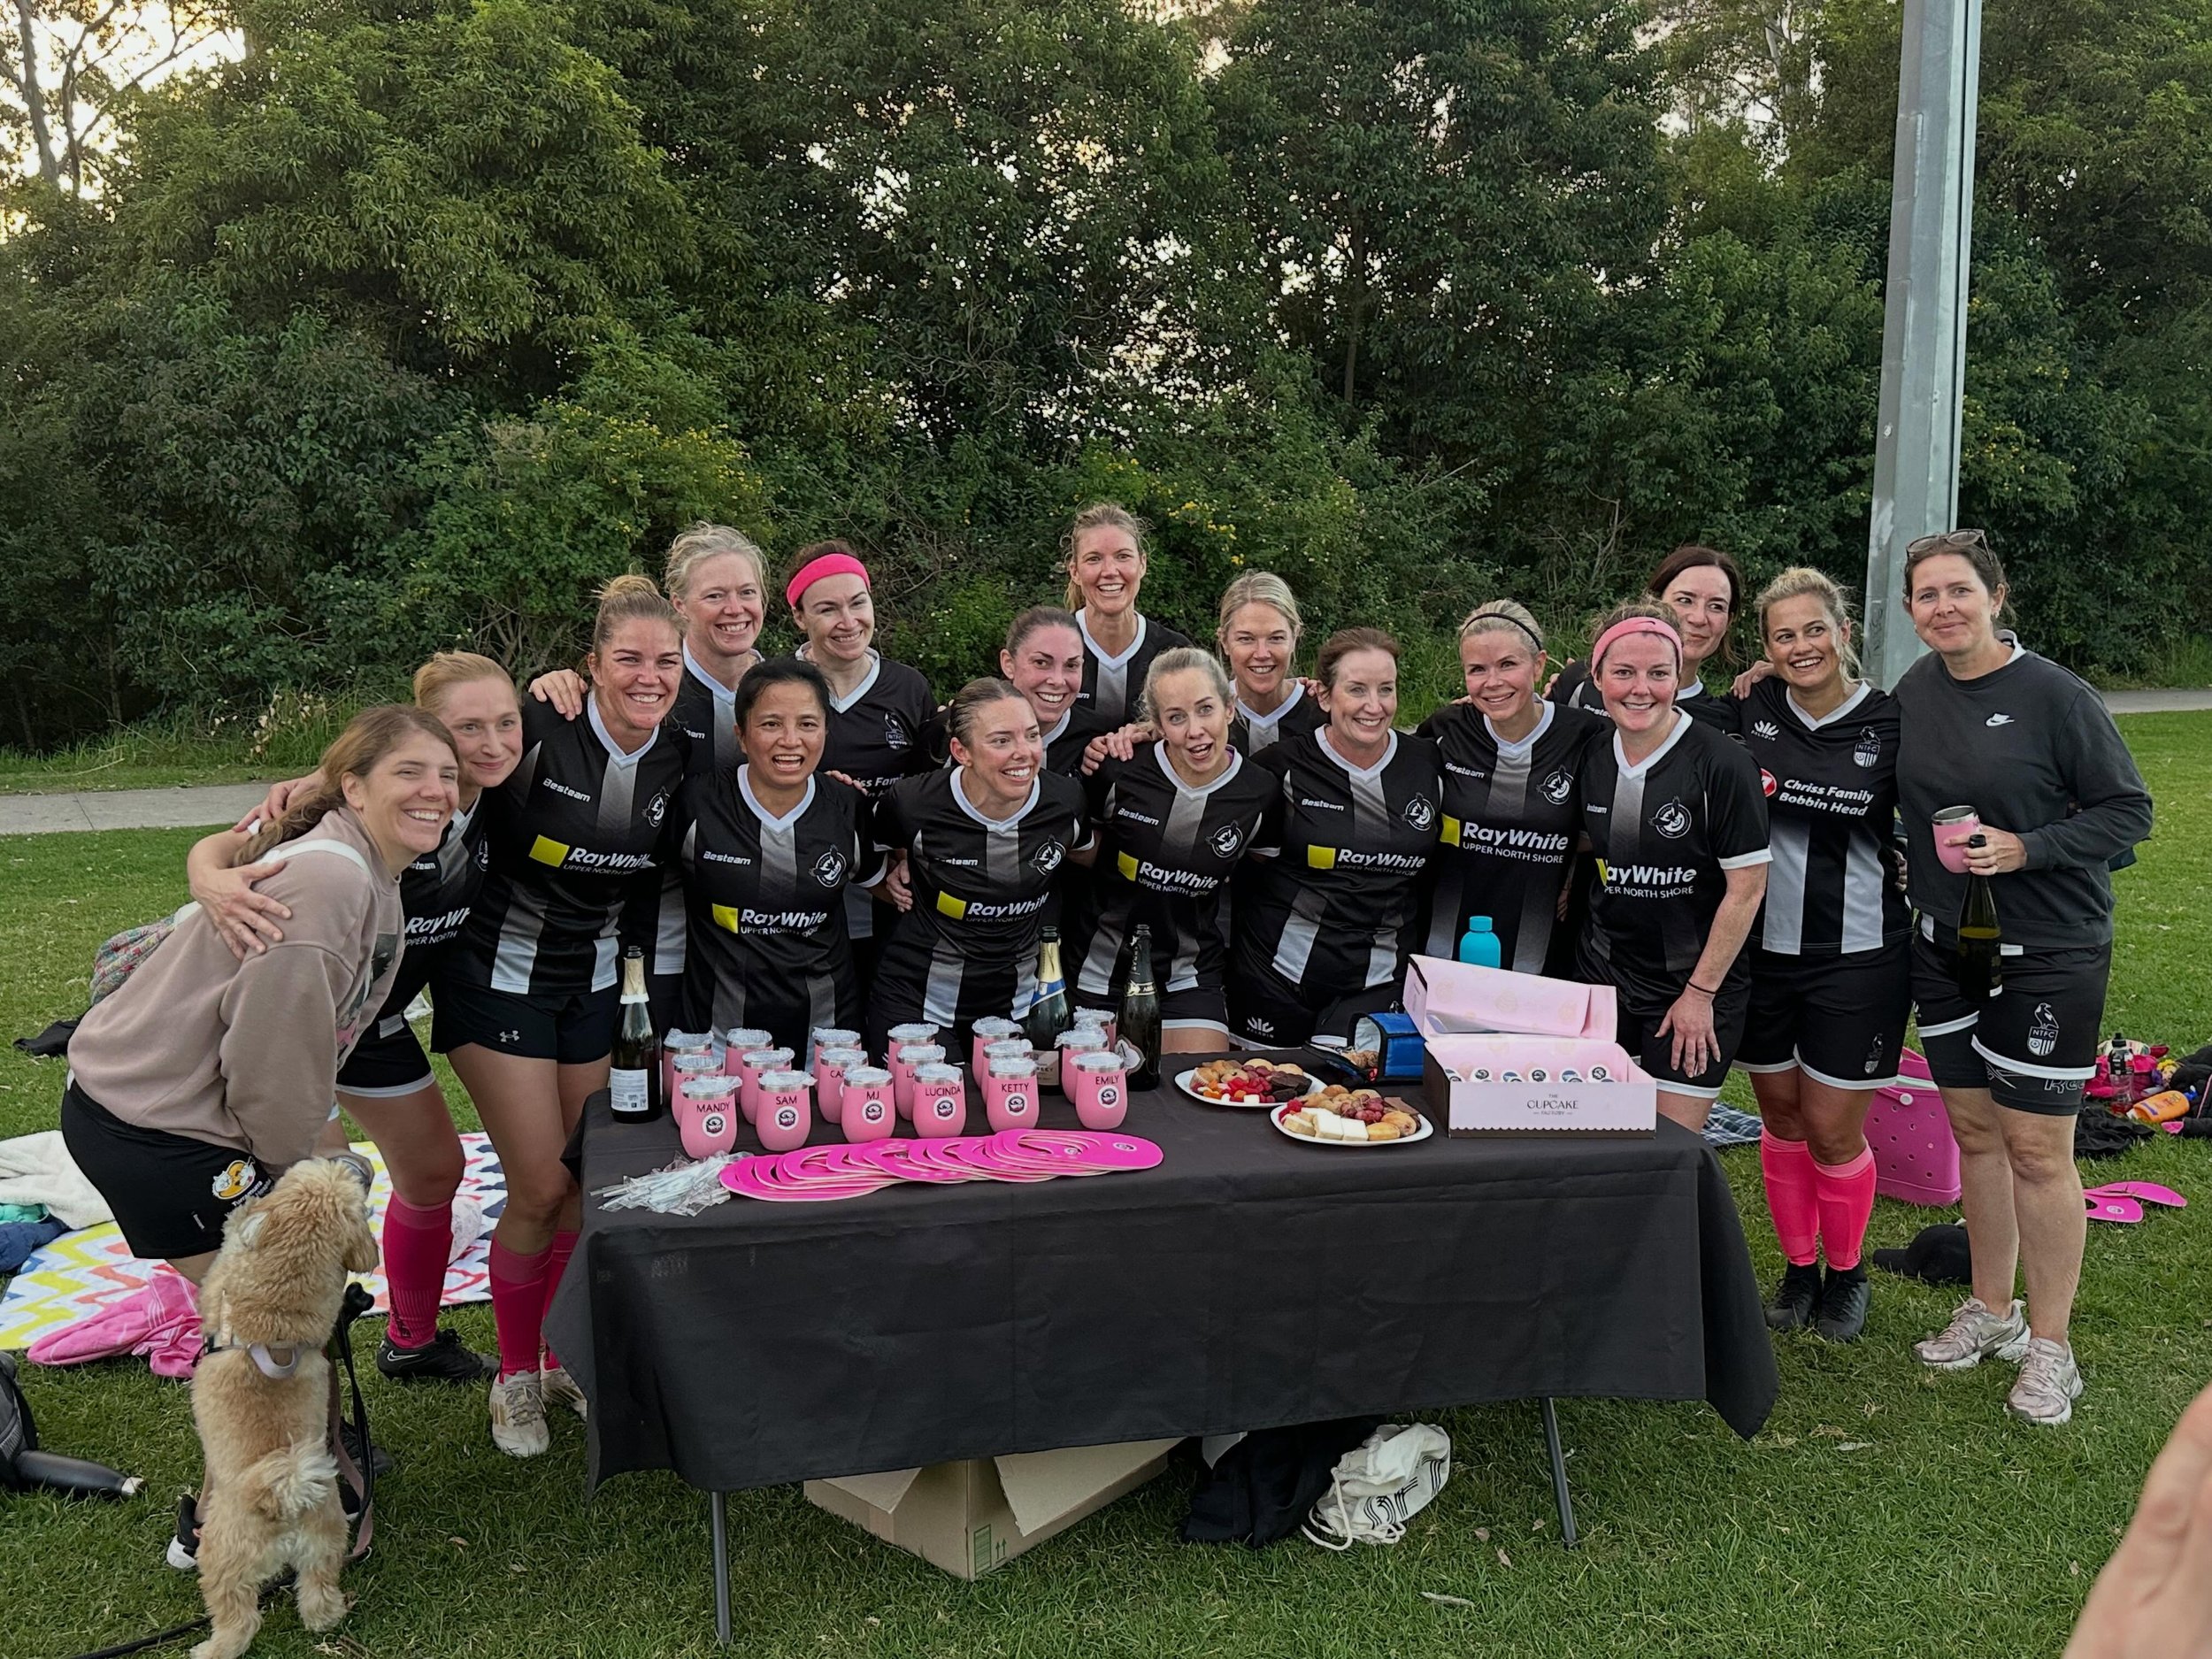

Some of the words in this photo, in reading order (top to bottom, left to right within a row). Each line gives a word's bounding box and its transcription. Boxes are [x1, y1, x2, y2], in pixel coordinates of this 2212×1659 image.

[1445, 762, 1486, 779] Besteam
[542, 778, 591, 803] Besteam
[1784, 779, 1825, 795] Chriss
[1826, 786, 1874, 803] Family
[1302, 798, 1345, 811] Besteam
[1778, 792, 1828, 810] Bobbin
[1829, 801, 1869, 817] Head
[1118, 807, 1159, 826] Besteam
[1463, 821, 1569, 850] RayWhite
[703, 850, 751, 865] Besteam
[1338, 849, 1426, 868] RayWhite
[1463, 841, 1494, 855] UPPER
[1495, 848, 1530, 861] NORTH
[1532, 854, 1564, 864] SHORE
[563, 864, 592, 873] UPPER
[1140, 862, 1218, 888] RayWhite
[1605, 862, 1697, 886] ayWhite
[1138, 878, 1162, 891] UPPER
[1163, 886, 1188, 895] NORTH
[1623, 887, 1658, 898] NORTH
[1660, 886, 1694, 898] SHORE
[741, 909, 828, 927] RayWhite
[405, 936, 428, 947] PPER
[429, 930, 458, 946] NORTH
[2032, 1029, 2055, 1039] NTFC
[1001, 1082, 1030, 1093] KETTY
[1095, 1074, 1120, 1086] EMILY
[866, 1091, 879, 1101] MJ
[925, 1085, 962, 1096] LUCINDA
[696, 1102, 731, 1113] MANDY
[775, 1095, 797, 1105] SAM
[1526, 1100, 1578, 1110] CUPCAKE
